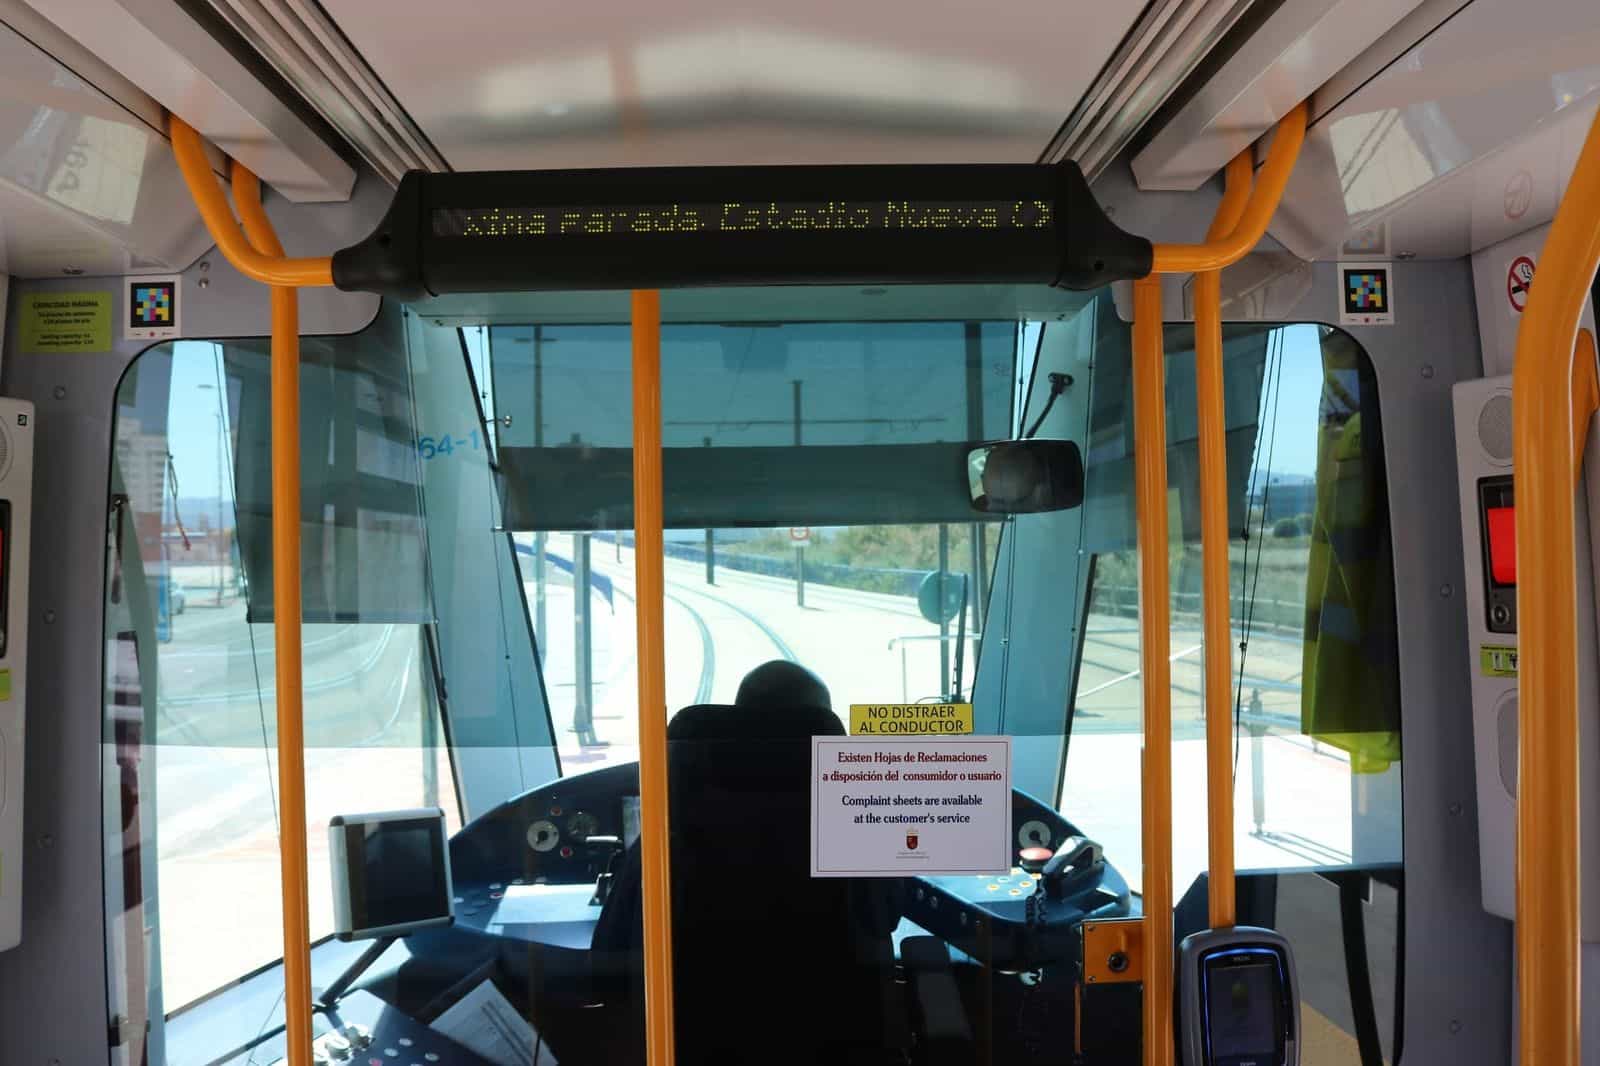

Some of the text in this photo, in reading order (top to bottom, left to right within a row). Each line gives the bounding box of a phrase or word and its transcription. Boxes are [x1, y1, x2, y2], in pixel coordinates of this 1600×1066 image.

[719, 201, 869, 231] Estadio
[883, 201, 998, 229] Nueva
[868, 706, 955, 719] NO DISTRAER
[859, 720, 963, 733] AL CONDUCTOR
[838, 752, 987, 765] Existen Hojas de Reclamaciones
[822, 770, 1002, 783] a disposición del consumidor o usuario
[841, 794, 983, 808] Complaint sheets are available
[853, 811, 970, 824] at the customer's service
